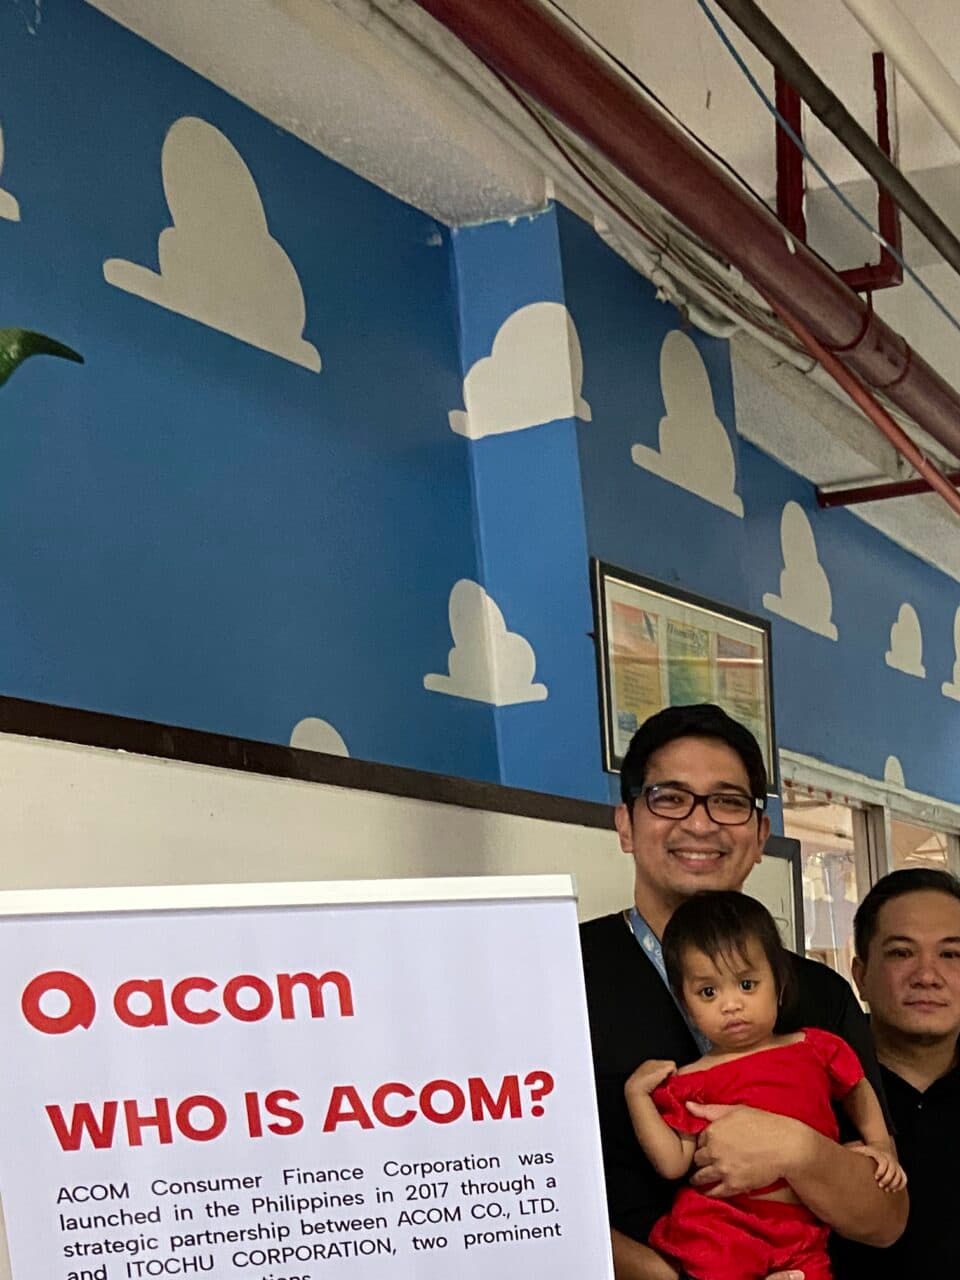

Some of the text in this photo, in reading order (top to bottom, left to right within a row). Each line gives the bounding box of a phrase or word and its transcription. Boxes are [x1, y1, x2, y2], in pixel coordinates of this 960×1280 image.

[113, 971, 354, 1028] acom
[45, 1070, 555, 1152] WHO IS ACOM?
[57, 1152, 554, 1205] ACOM Consumer Finance Corporation was
[60, 1174, 556, 1231] launched in the Philippines in 2017 through a
[64, 1197, 558, 1258] strategic partnership between ACOM CO., LTD.
[127, 1254, 214, 1278] ITOCHU
[232, 1237, 396, 1268] CORPORATION,
[412, 1236, 447, 1251] two
[464, 1222, 561, 1250] prominent
